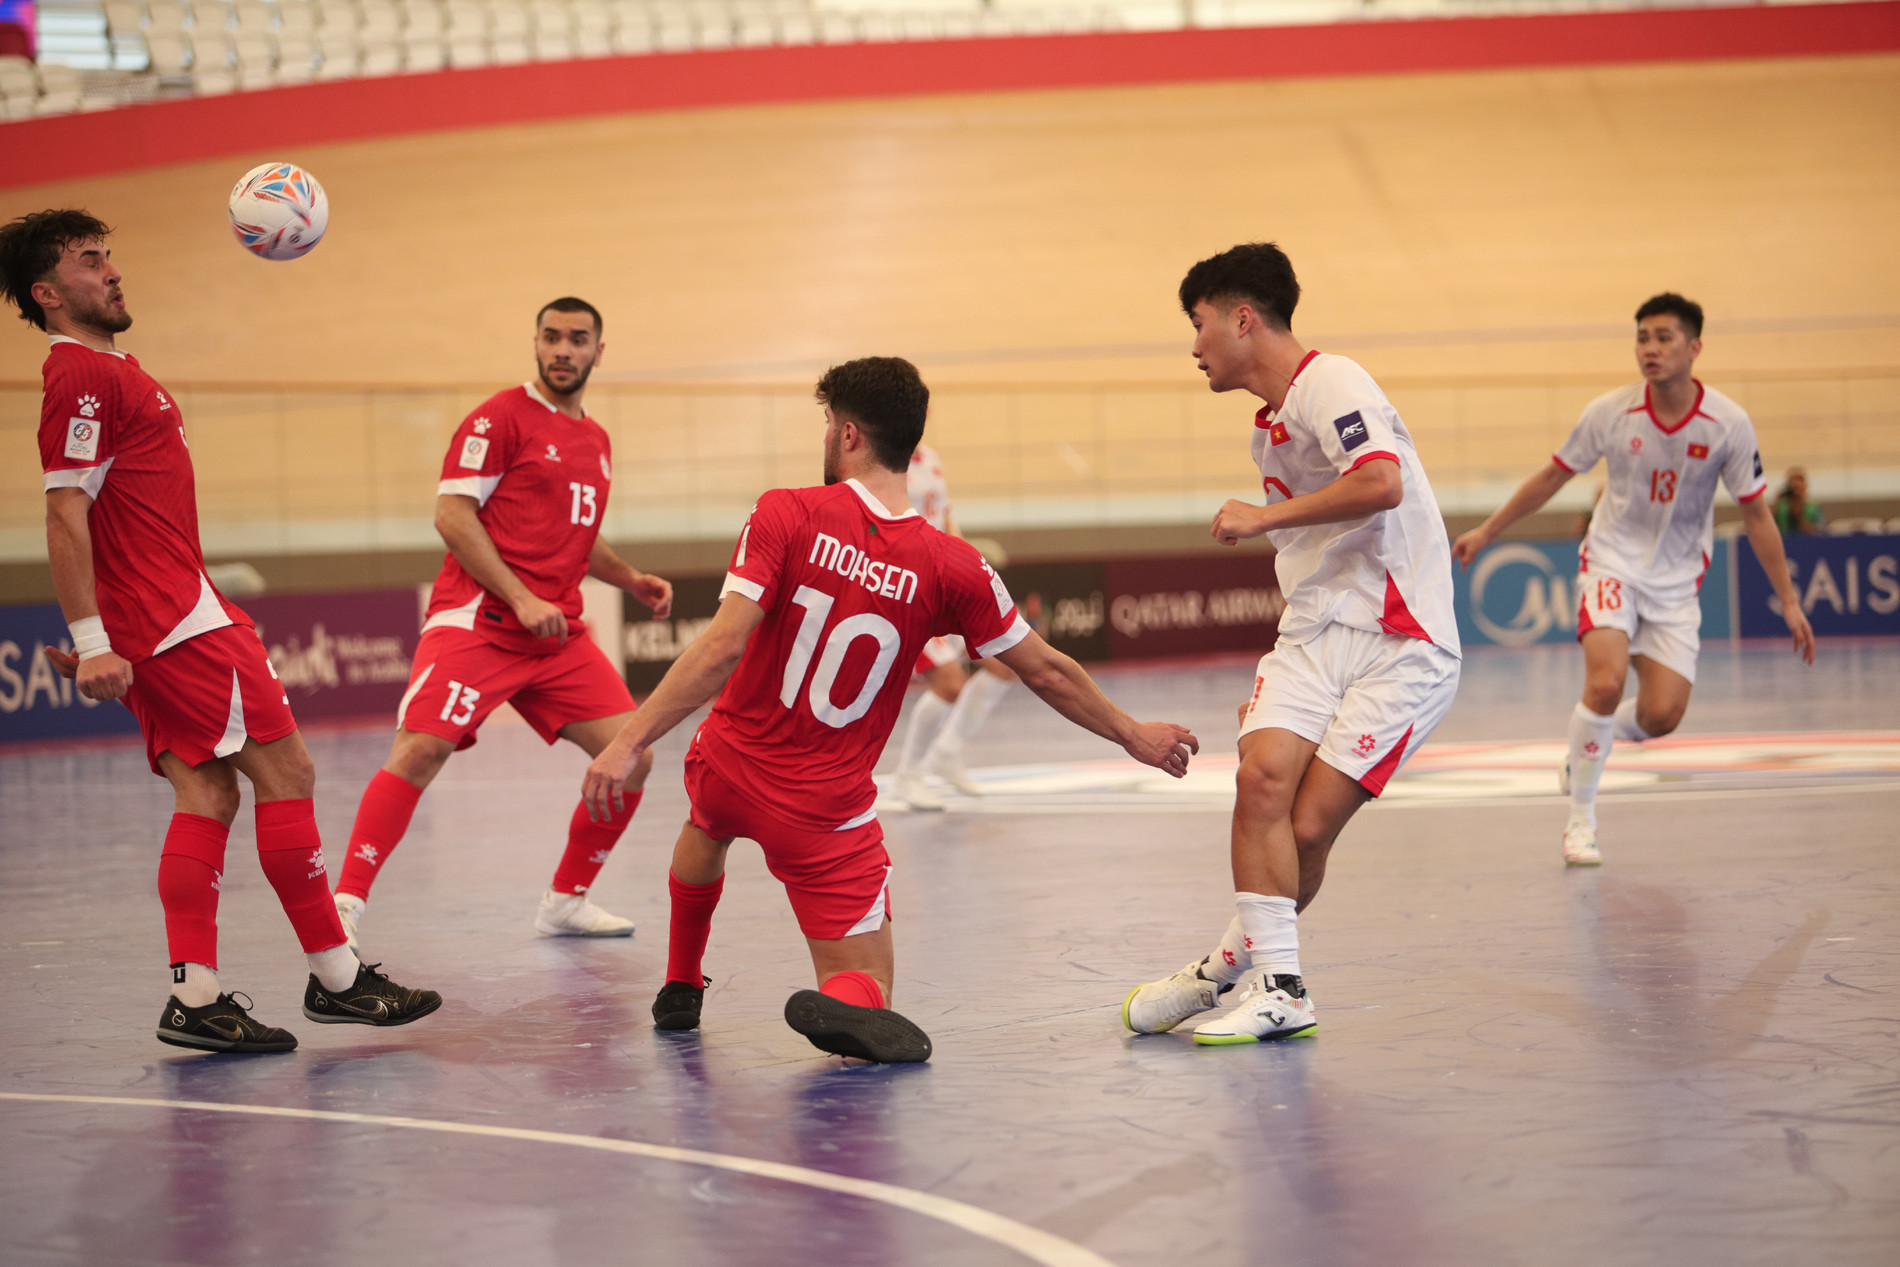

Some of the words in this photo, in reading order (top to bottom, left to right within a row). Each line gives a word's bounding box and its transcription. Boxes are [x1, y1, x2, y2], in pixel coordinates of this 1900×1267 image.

[1341, 421, 1364, 438] AFC
[569, 482, 597, 528] 13
[1649, 465, 1674, 505] 13
[809, 532, 918, 604] MOHSEN
[1598, 578, 1622, 611] 13
[624, 617, 714, 662] KELM
[781, 585, 901, 729] 10
[439, 679, 480, 727] 13
